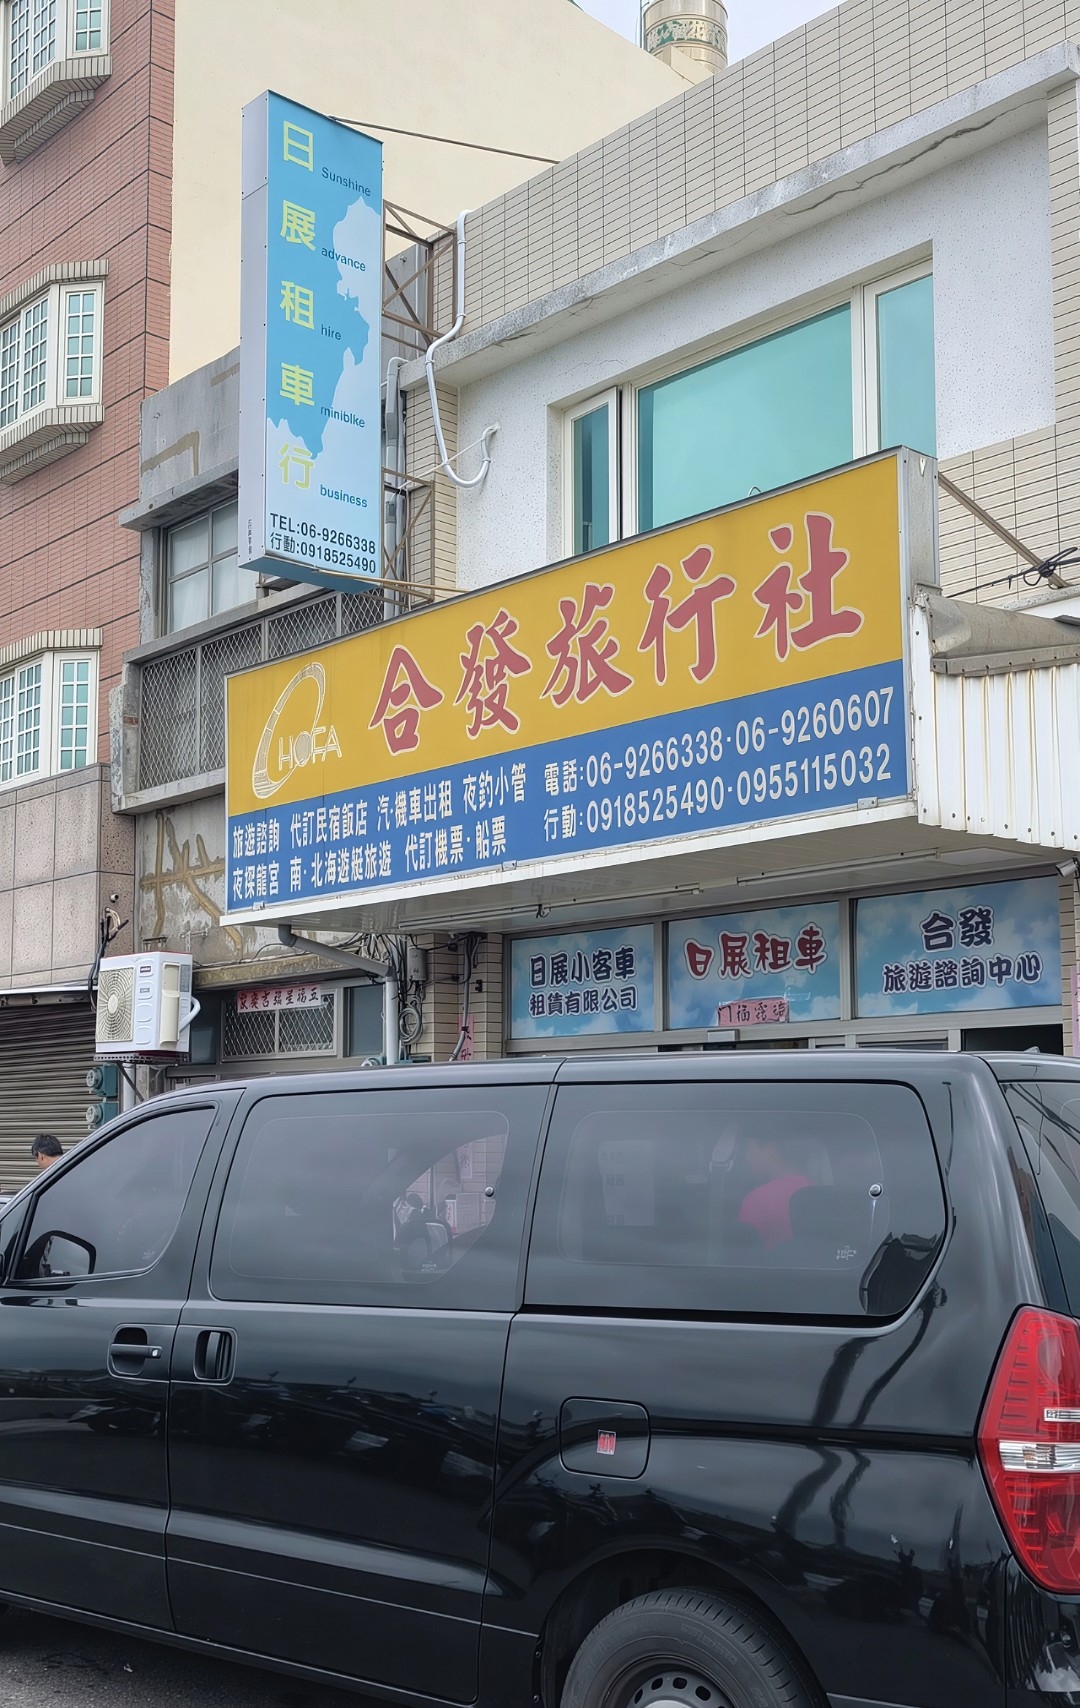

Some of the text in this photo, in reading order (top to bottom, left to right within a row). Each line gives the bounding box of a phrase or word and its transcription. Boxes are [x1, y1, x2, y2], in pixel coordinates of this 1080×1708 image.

[321, 167, 371, 196] Sunshine
[321, 246, 366, 272] advance
[278, 120, 316, 490] 日展租車行
[321, 324, 342, 341] hire
[320, 484, 368, 508] business
[270, 512, 376, 555] TEL:06-9266338
[270, 532, 376, 574] 行動:0918525490
[368, 510, 866, 757] 合發旅行社
[232, 817, 280, 859] 旅遊諮詢
[290, 799, 368, 849] 代訂民宿飯店
[462, 762, 526, 814] 夜釣小管
[232, 860, 280, 902] 夜探龍宮
[920, 905, 994, 952] 合發
[529, 945, 637, 988] 日展小客車
[684, 922, 828, 979] 日展租車
[882, 951, 1043, 995] 旅遊諮詢中心
[529, 984, 638, 1018] 租賃有限公司
